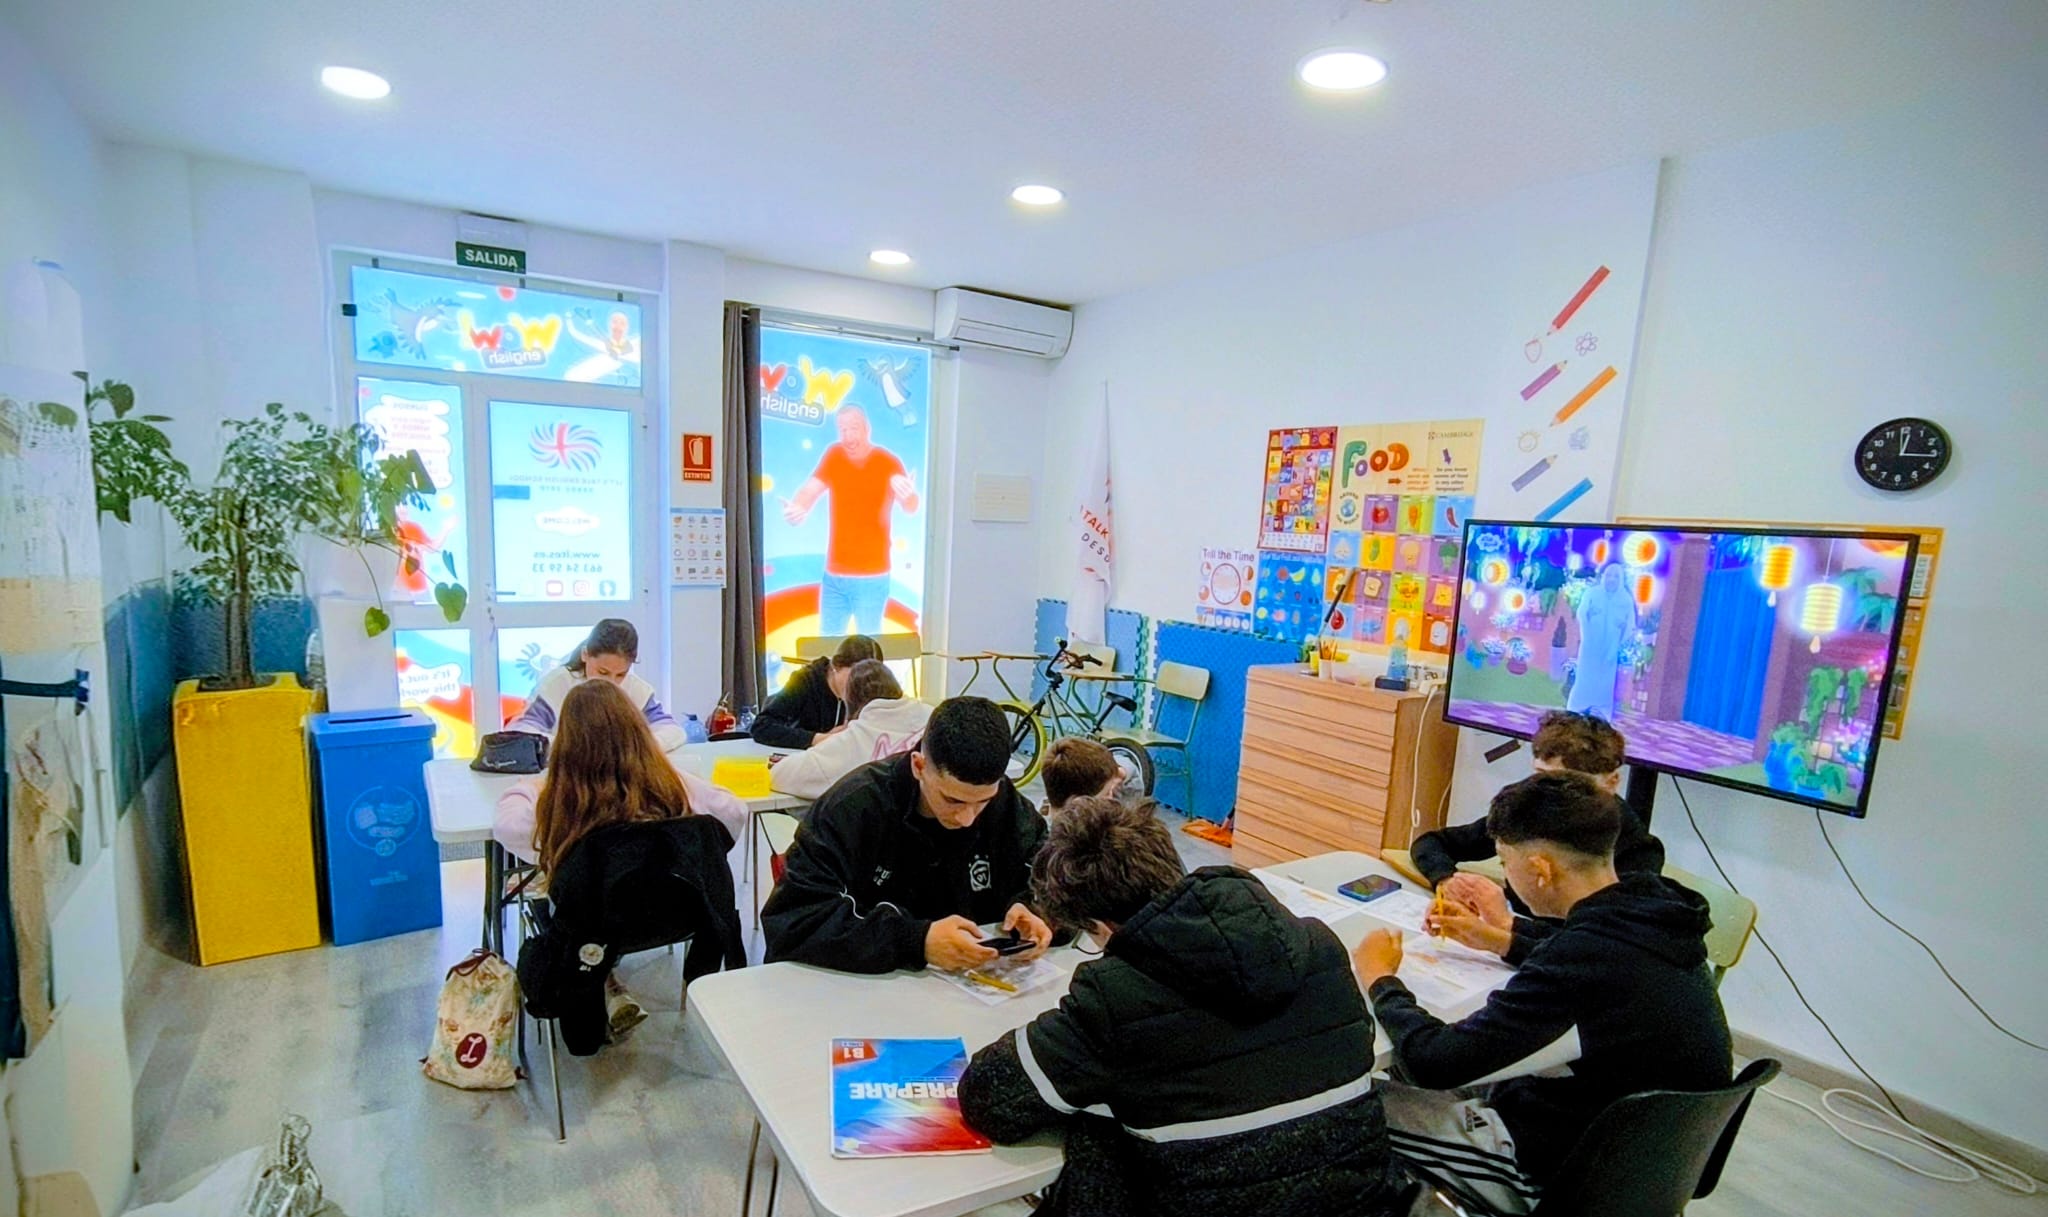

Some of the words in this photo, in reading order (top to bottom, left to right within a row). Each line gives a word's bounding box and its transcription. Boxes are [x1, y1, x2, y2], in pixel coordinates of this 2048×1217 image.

[465, 249, 518, 268] SALIDA
[1342, 440, 1411, 489] FOOD
[684, 471, 711, 480] EXTINTOR
[1083, 510, 1109, 539] TALK
[1217, 548, 1232, 560] the
[1233, 550, 1255, 562] Time
[844, 1047, 864, 1059] B1
[850, 1082, 959, 1100] PREPARE
